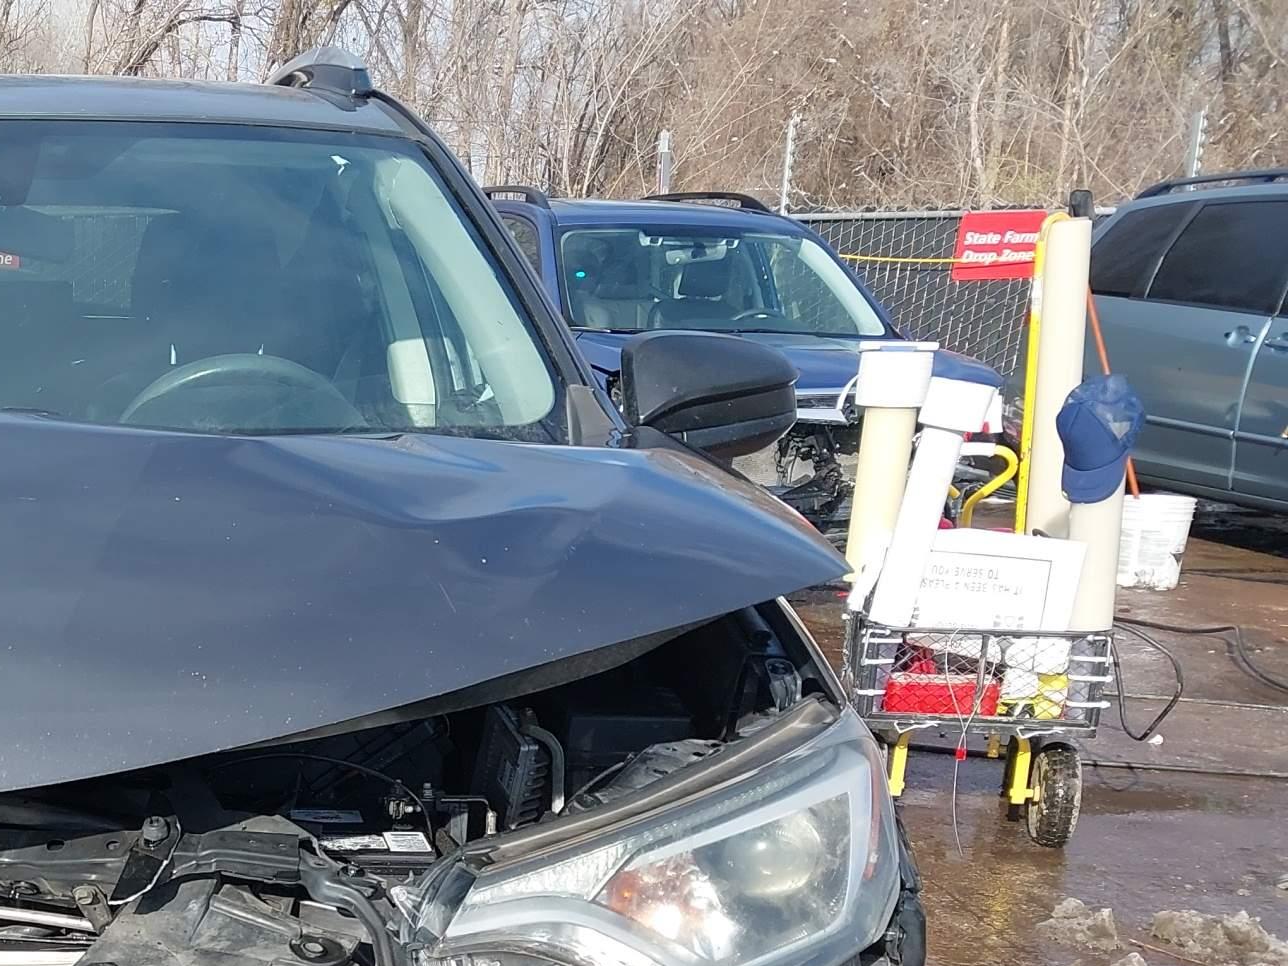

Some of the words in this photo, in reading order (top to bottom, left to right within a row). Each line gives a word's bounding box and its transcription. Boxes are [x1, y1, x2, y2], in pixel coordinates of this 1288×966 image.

[964, 231, 1001, 245] State
[1004, 230, 1039, 244] Farm
[962, 249, 997, 265] Drop
[954, 567, 983, 578] SERVE
[987, 568, 999, 580] TO
